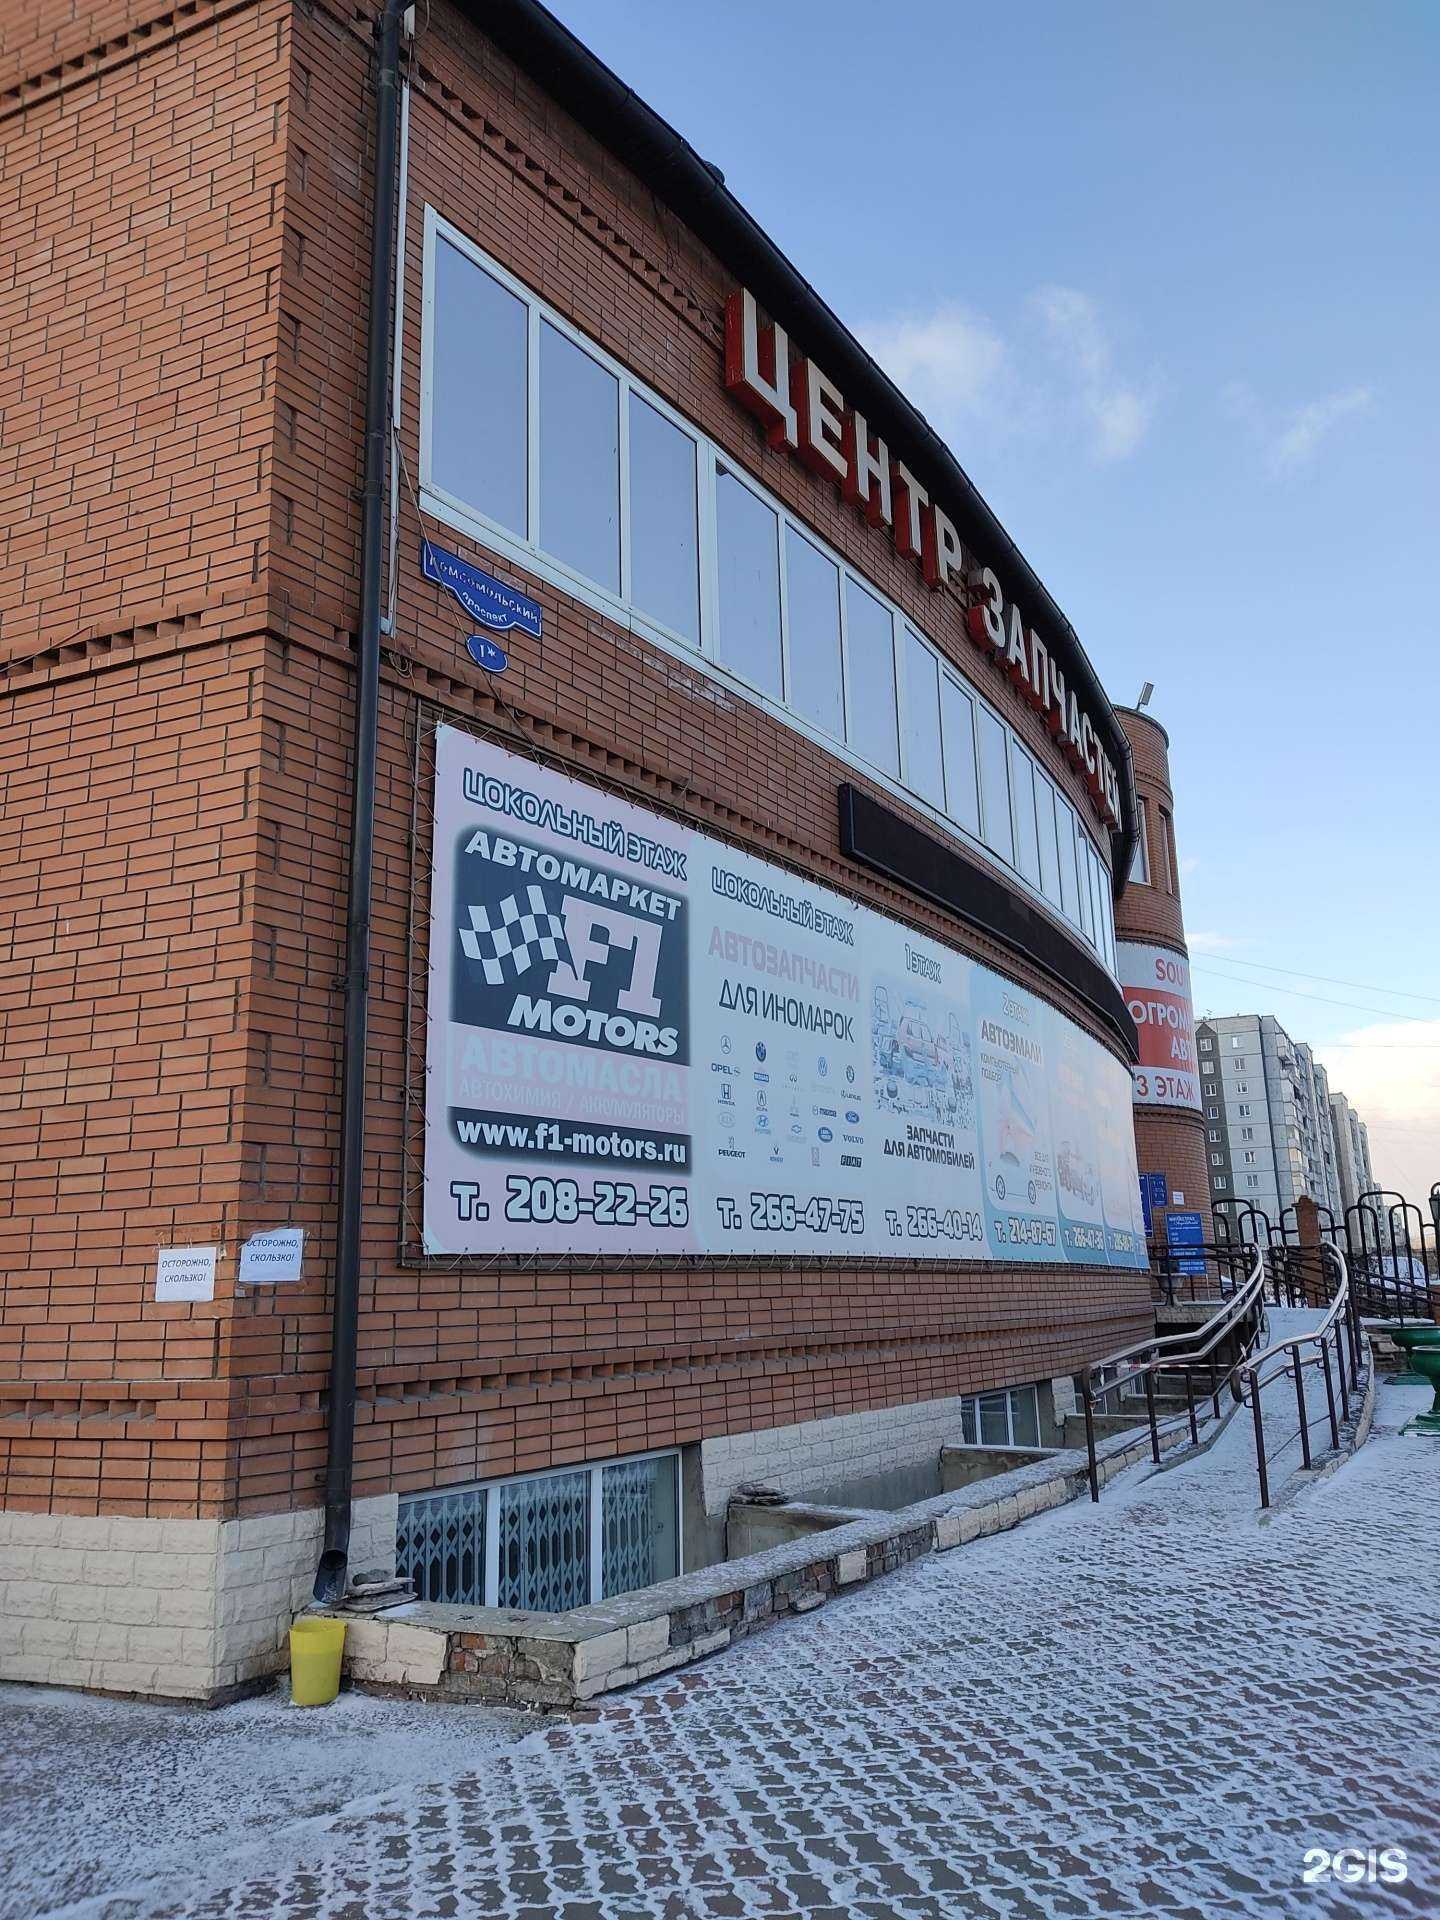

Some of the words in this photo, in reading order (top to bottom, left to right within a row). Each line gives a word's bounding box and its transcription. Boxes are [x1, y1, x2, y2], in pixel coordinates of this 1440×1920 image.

[728, 286, 963, 586] ЦЕНТР
[463, 767, 625, 858] ЦОКОЛЬНЫЙ
[626, 832, 689, 881] ЭТАЖ
[464, 830, 682, 922] АВТОМАРКЕТ
[712, 866, 814, 928] ЦОКОЛЬНЫЙ
[814, 908, 855, 945] ЭТАЖ
[545, 895, 664, 1019] F1
[708, 926, 861, 1003] АВТОЗАПЧАСТИ
[911, 951, 942, 984] ЭТАЖ
[506, 993, 680, 1058] MOTORS
[719, 979, 758, 1018] ДЛЯ
[762, 990, 855, 1044] ИНОМАРОК
[981, 1019, 1041, 1065] АВТОЭМАЛИ
[461, 1033, 682, 1102] АВТОМАСЛА
[711, 1062, 733, 1075] OPEL
[1154, 1075, 1195, 1102] ЭТАЖ
[456, 1120, 687, 1164] www.f1-motors.ru
[718, 1148, 746, 1159] PEUGEOT
[842, 1134, 864, 1145] VOLVO
[884, 1139, 906, 1158] ДЛЯ
[907, 1143, 975, 1171] АВТОМОБИЛЕЙ
[906, 1124, 955, 1149] ЗАПЧАСТИ
[840, 1154, 862, 1168] FIAT
[506, 1175, 689, 1227] 208-22-26
[749, 1191, 865, 1235] 266-47-75
[906, 1204, 984, 1242] 266-40-14
[161, 1258, 212, 1270] ОСТОРОЖНО,
[246, 1239, 299, 1249] ОСТОРОЖНО,
[249, 1253, 295, 1263] СКОЛЬЗКО!
[164, 1273, 206, 1284] СКОЛЬЗКО!
